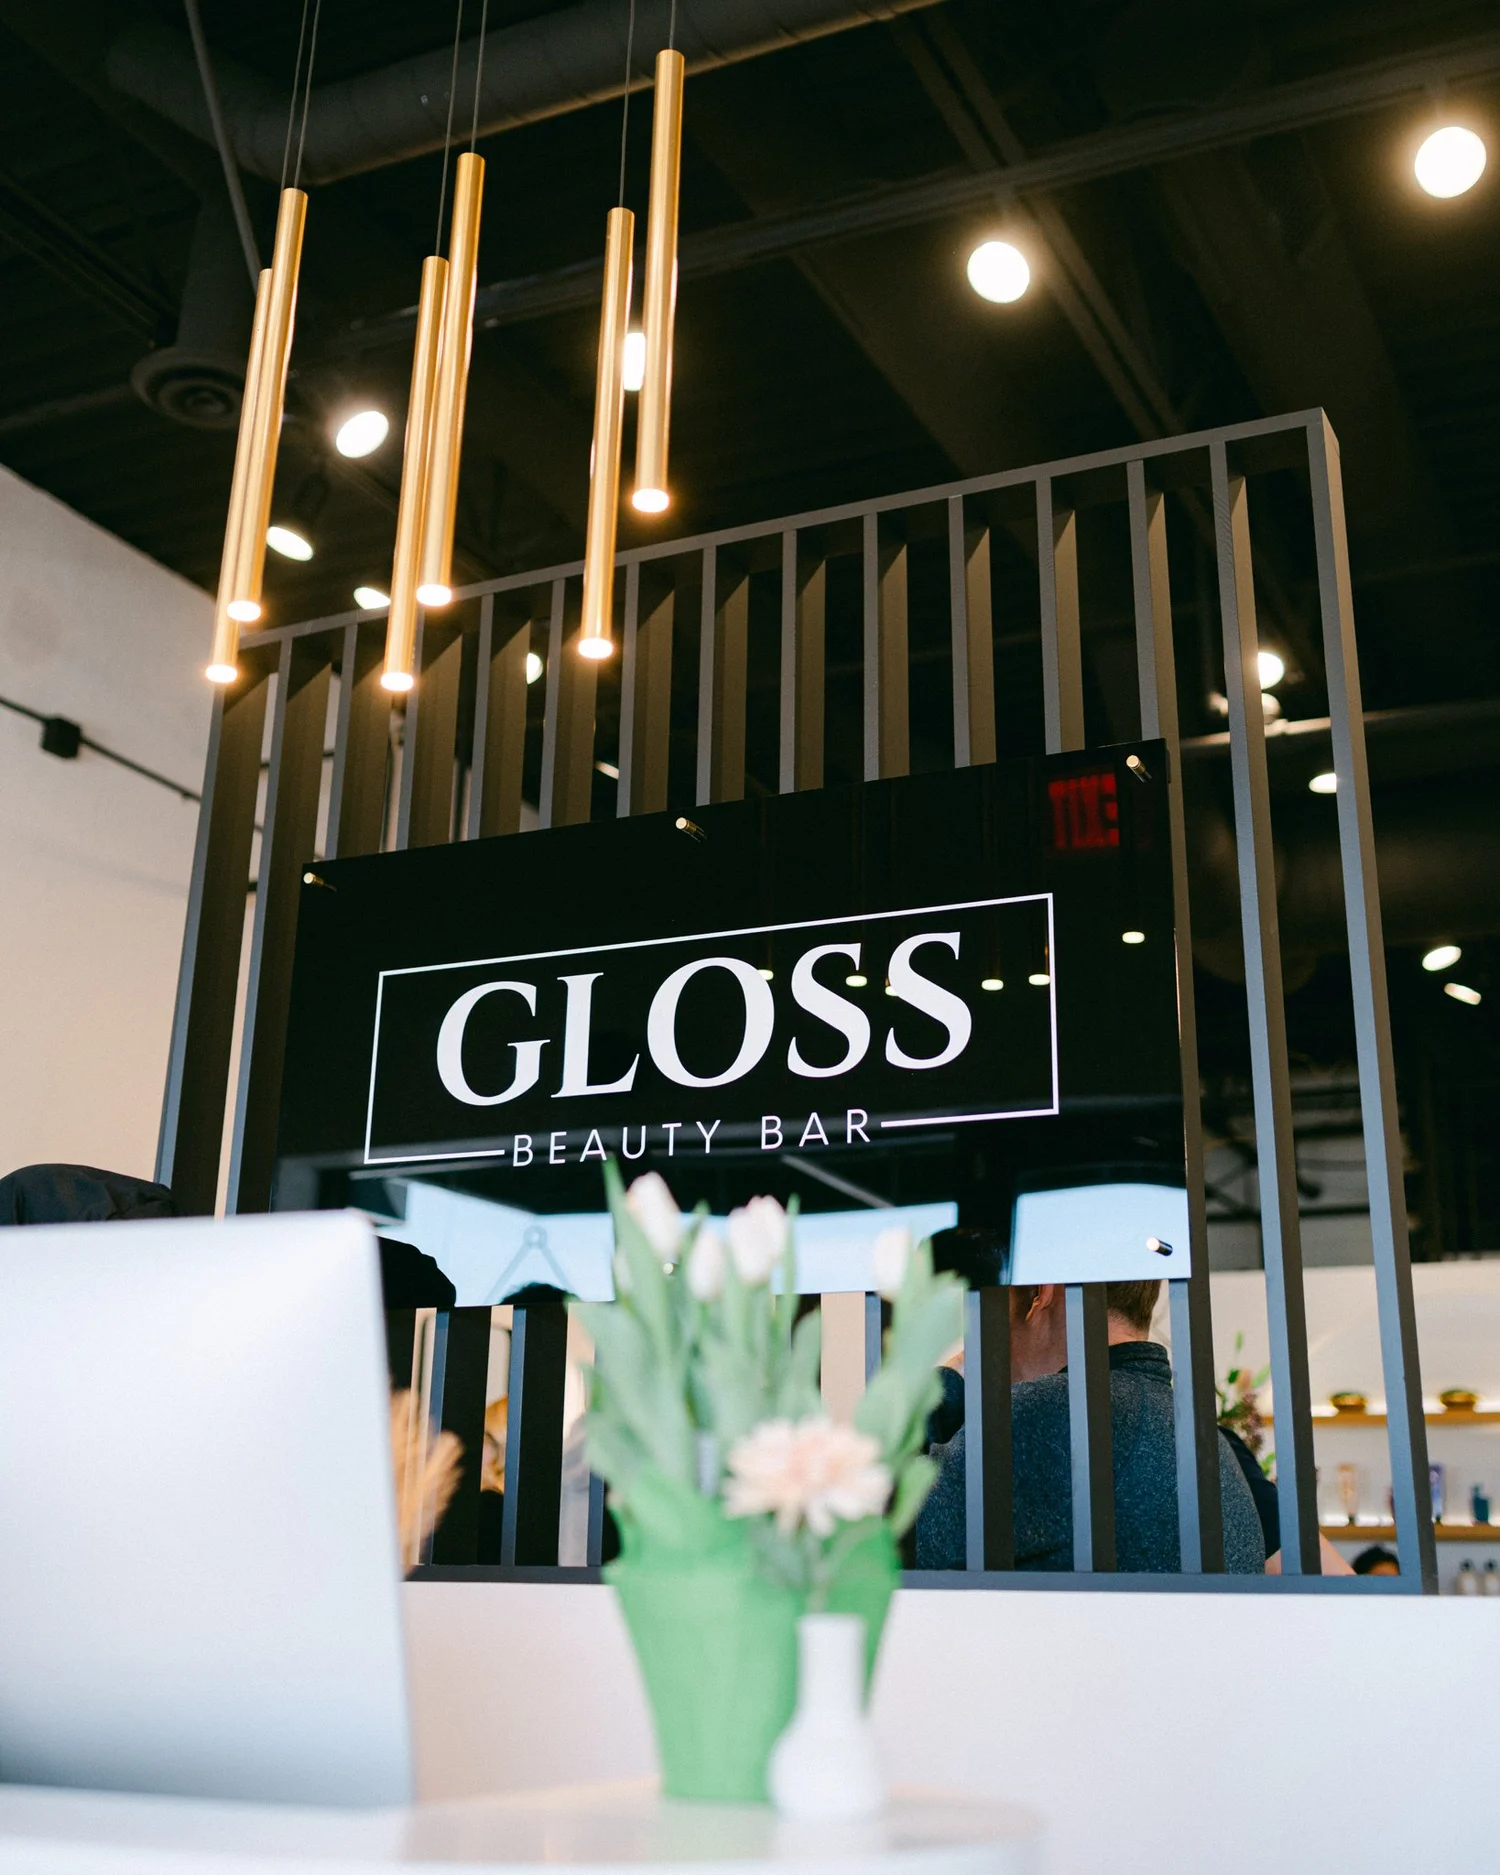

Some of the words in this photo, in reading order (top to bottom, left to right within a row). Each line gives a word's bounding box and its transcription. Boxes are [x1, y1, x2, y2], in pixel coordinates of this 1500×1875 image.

[436, 931, 972, 1106] GLOSS
[512, 1119, 721, 1167] BEAUTY
[760, 1108, 871, 1150] BAR
